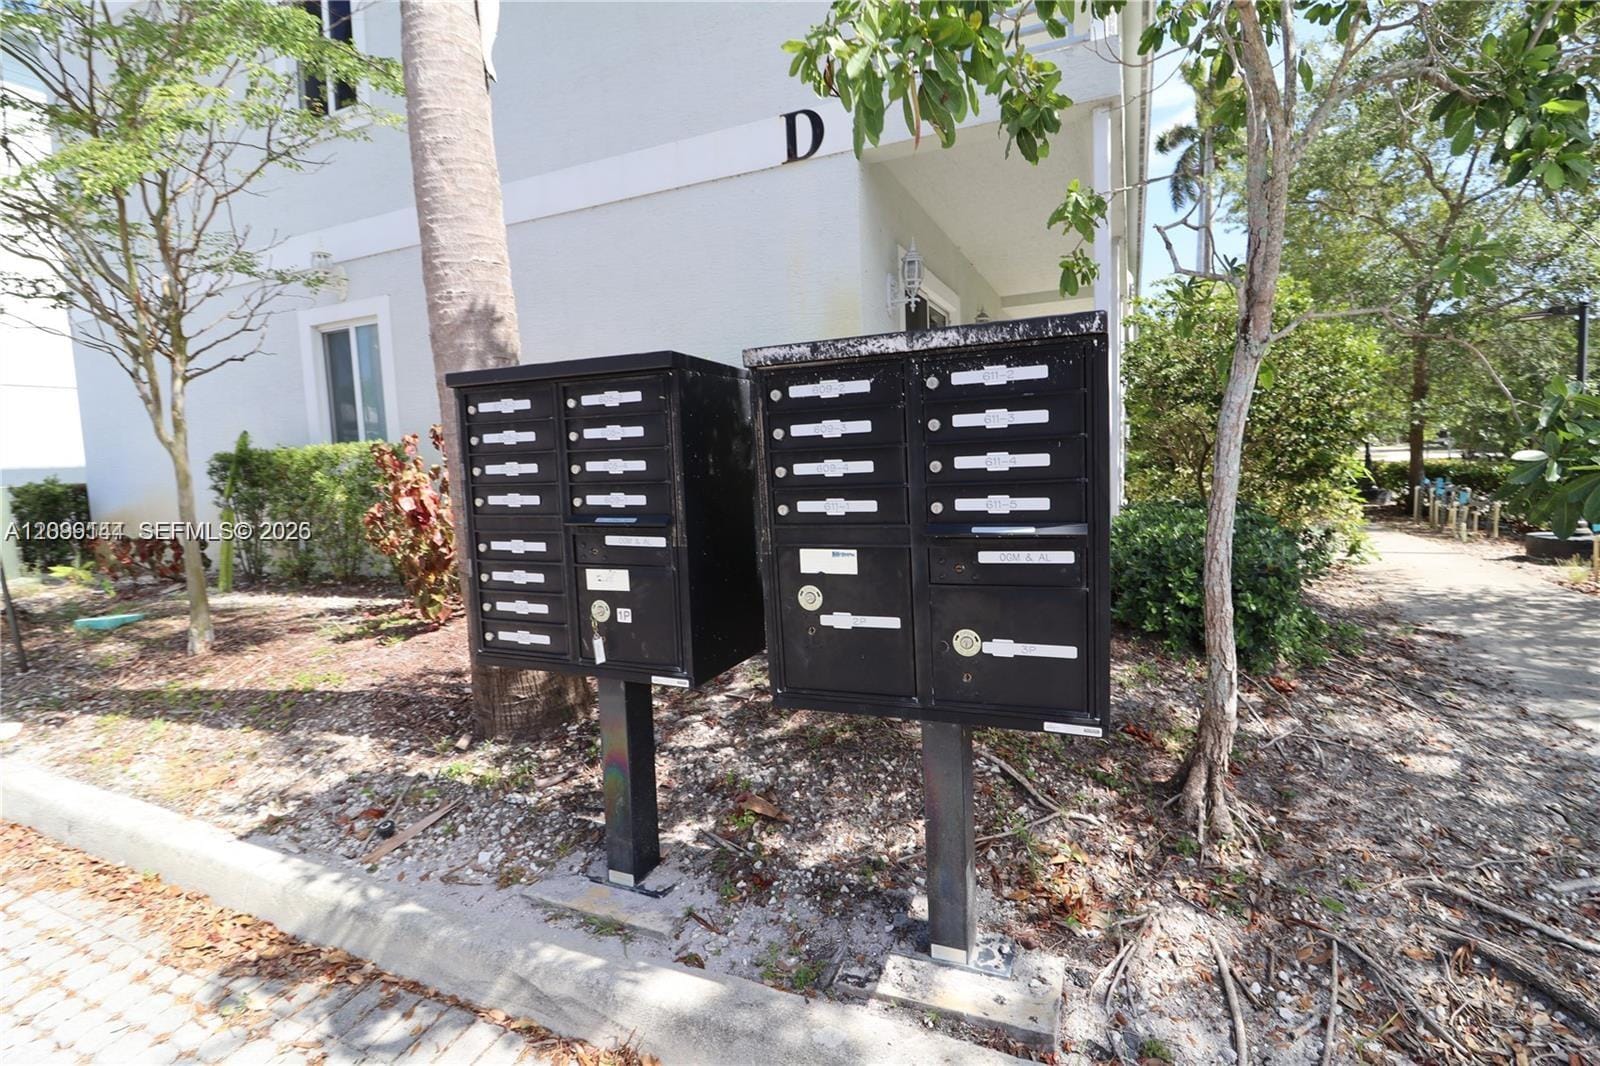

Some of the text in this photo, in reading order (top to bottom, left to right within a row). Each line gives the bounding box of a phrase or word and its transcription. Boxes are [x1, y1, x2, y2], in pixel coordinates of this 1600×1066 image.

[779, 109, 825, 165] D
[982, 369, 1015, 380] 611-2
[812, 383, 846, 394] 609-2
[983, 413, 1016, 424] 611-3
[814, 423, 847, 434] 609-3
[984, 456, 1017, 466] 611-4
[816, 463, 849, 473] 609-4
[823, 502, 850, 511] 611-1
[985, 500, 1018, 509] 611-5
[999, 553, 1052, 562] OGM & AL
[618, 610, 631, 621] 1P
[852, 617, 867, 626] 2P
[1021, 645, 1037, 655] 3P
